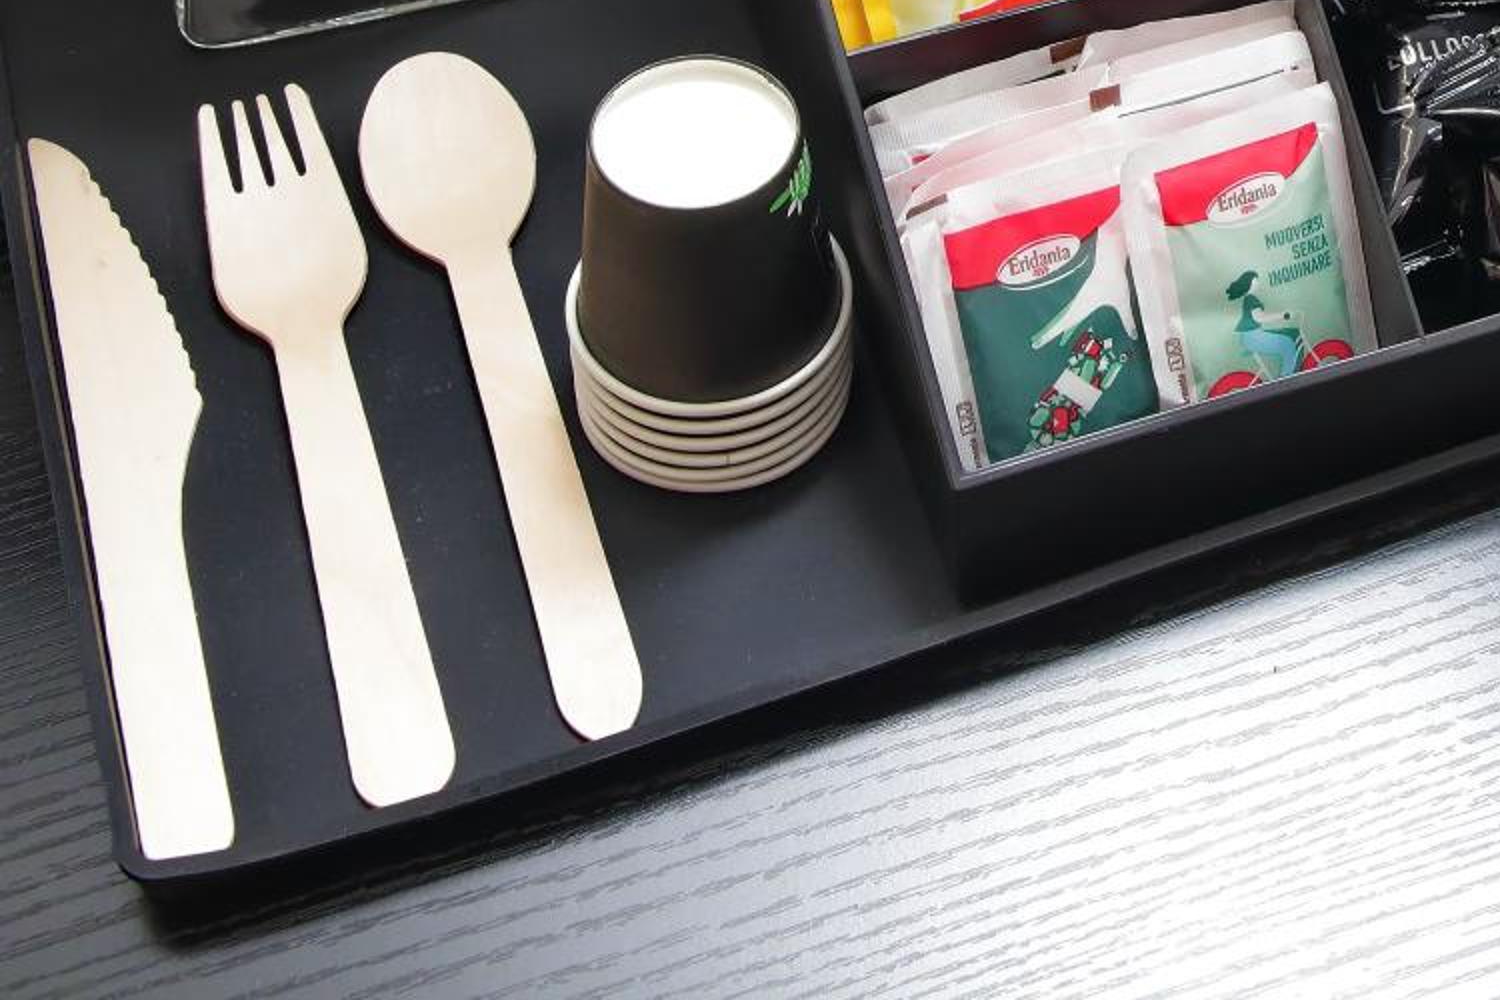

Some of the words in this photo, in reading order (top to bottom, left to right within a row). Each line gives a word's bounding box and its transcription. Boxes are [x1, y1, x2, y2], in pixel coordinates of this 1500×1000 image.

[1217, 184, 1277, 212] Eridania
[1264, 214, 1325, 250] MUOVERSI
[1291, 233, 1329, 260] SENZA
[1008, 246, 1071, 276] Eridania
[1267, 250, 1333, 287] INQUINARE
